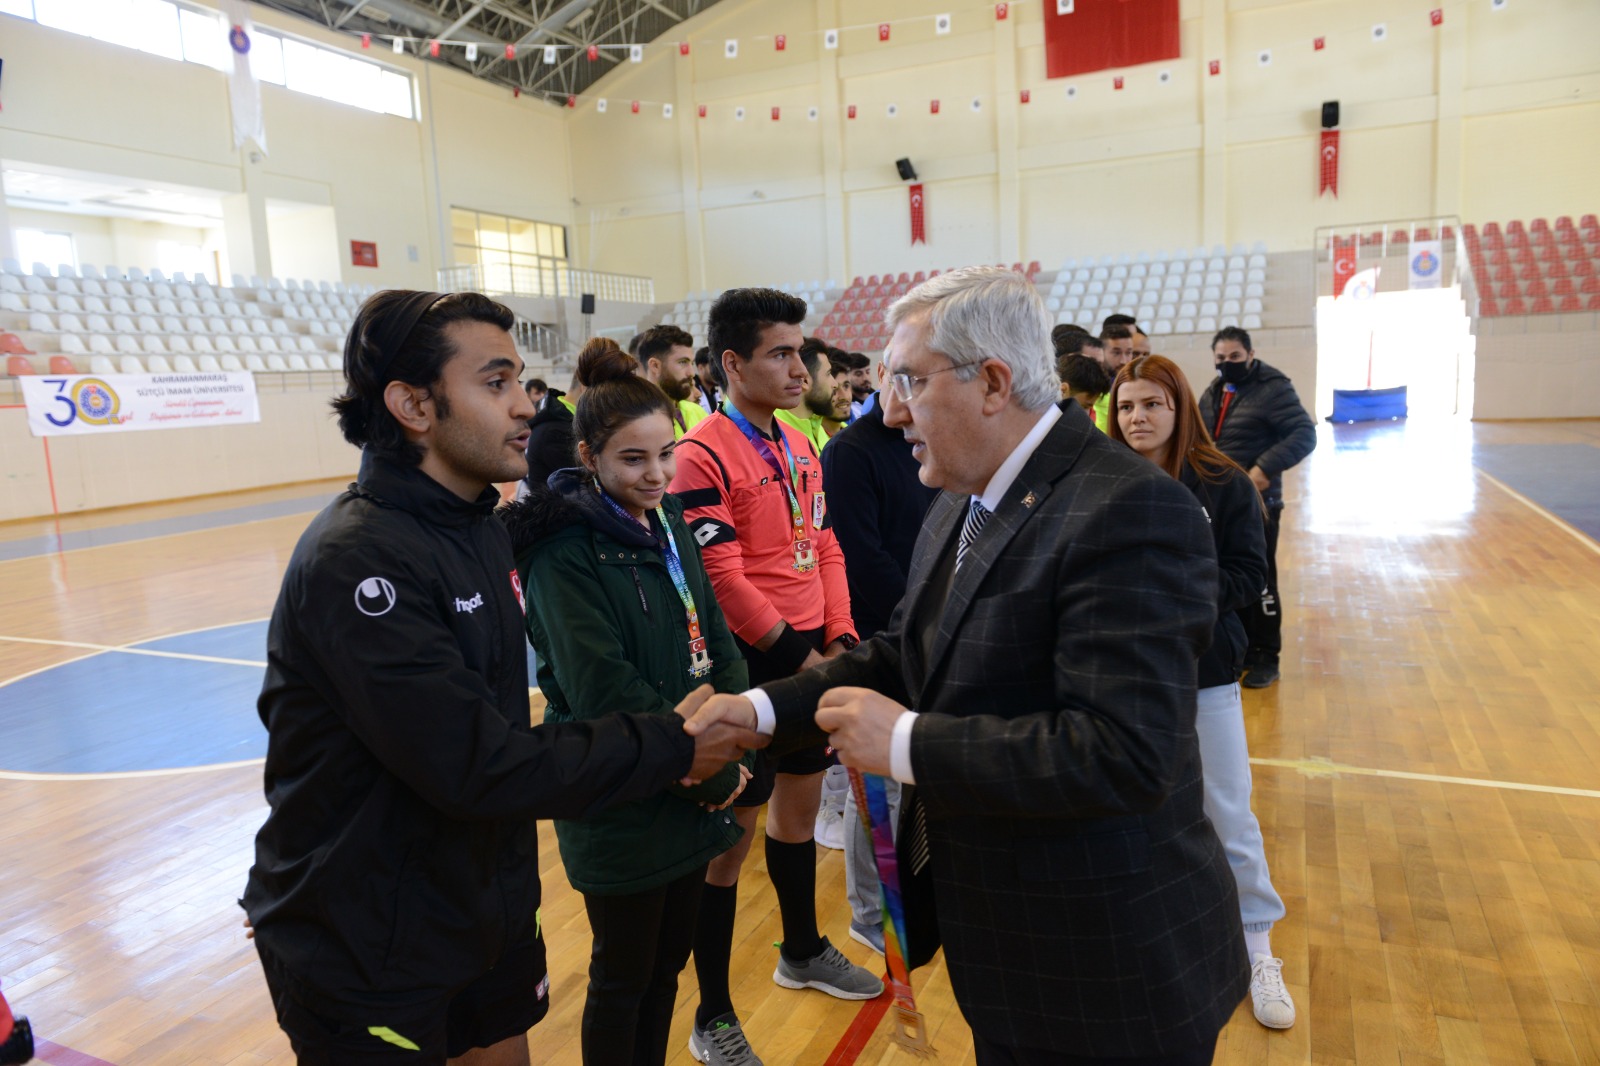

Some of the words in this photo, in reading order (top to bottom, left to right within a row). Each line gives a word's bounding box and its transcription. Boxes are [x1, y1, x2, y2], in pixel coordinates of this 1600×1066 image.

[151, 373, 228, 385] KAHRAMANMARAŞ
[136, 386, 165, 398] SÜTÇÜ
[166, 386, 192, 396] İMAM
[194, 384, 245, 395] ÜNİVERSİTESİ
